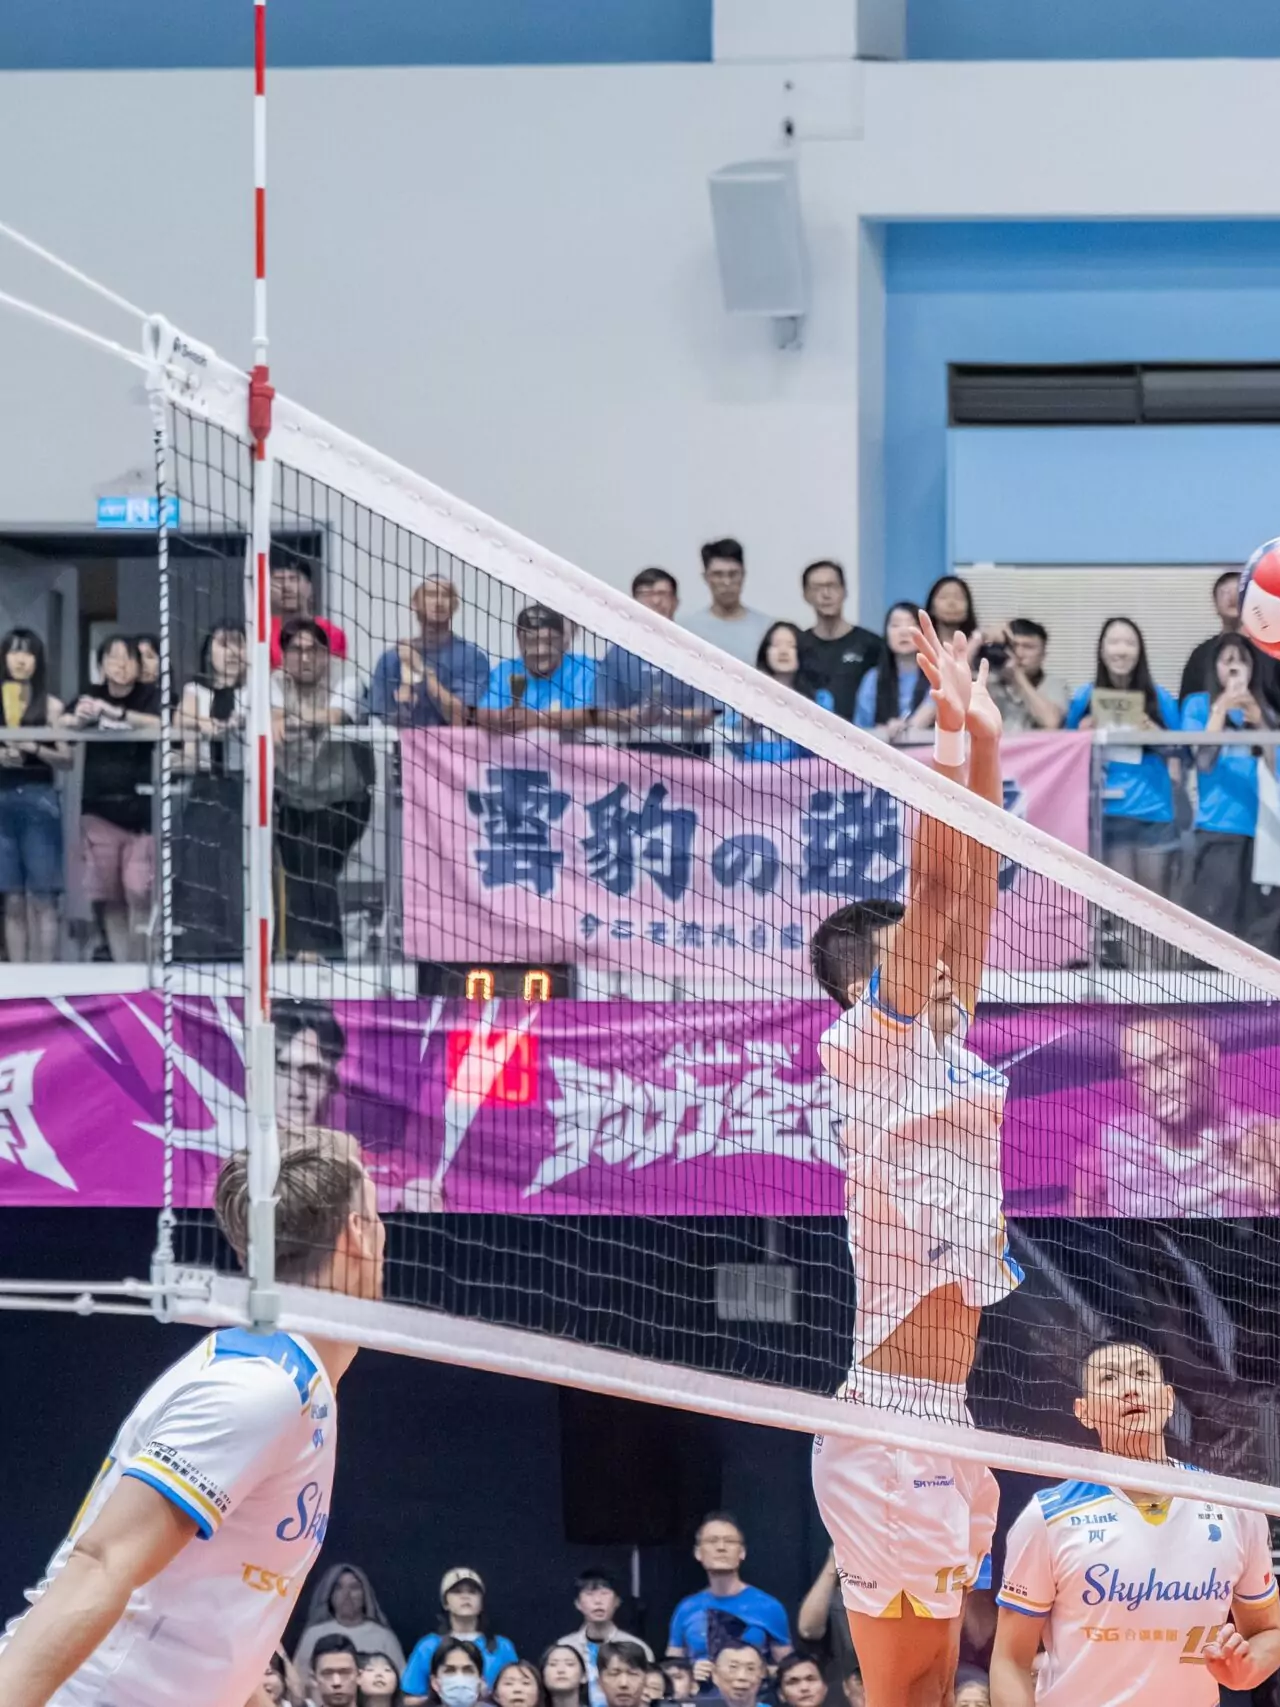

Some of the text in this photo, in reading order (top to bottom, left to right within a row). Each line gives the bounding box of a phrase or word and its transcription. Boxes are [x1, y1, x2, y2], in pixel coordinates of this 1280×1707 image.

[1070, 1512, 1119, 1526] D-Link
[1082, 1563, 1231, 1611] Skyhawks
[1080, 1626, 1119, 1642] TSG
